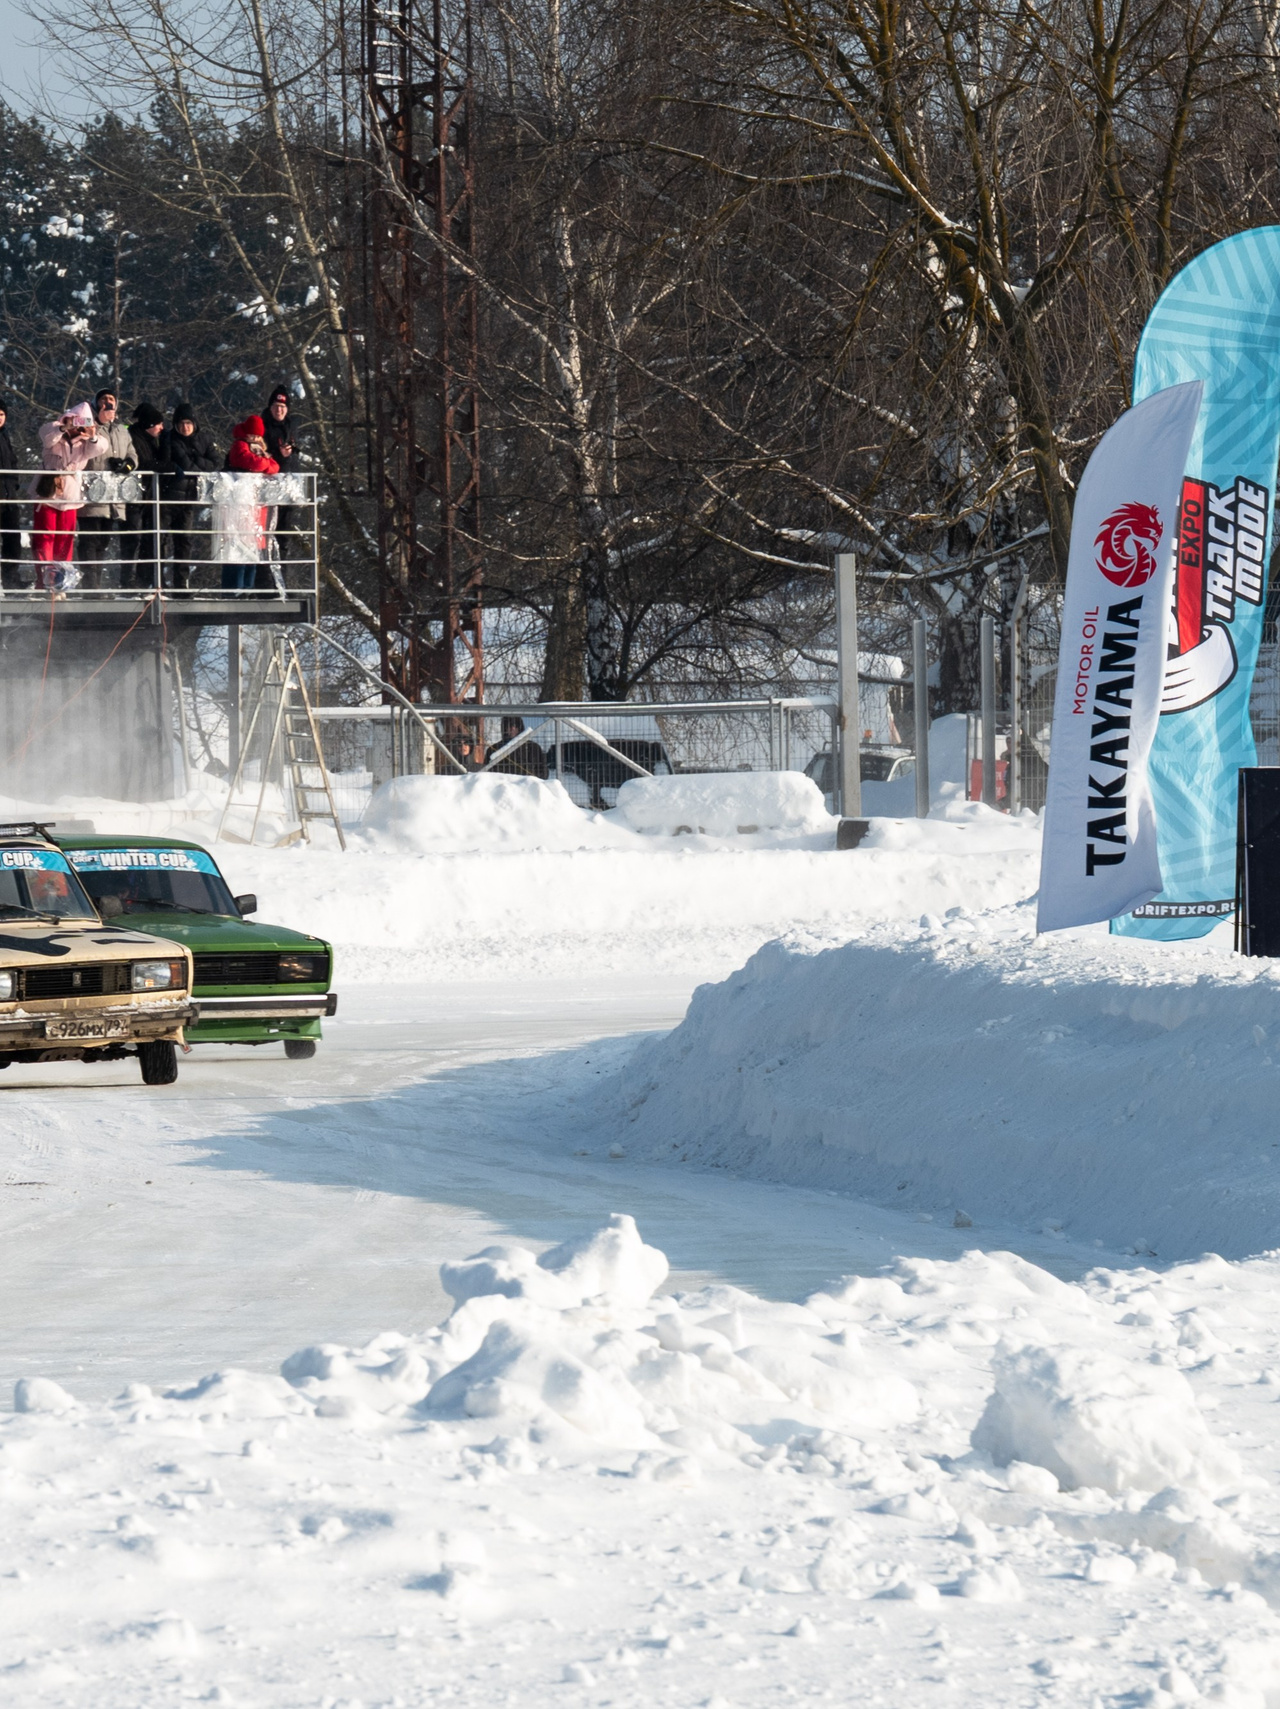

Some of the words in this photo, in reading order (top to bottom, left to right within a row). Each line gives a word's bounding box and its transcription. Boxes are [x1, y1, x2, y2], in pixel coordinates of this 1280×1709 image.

[1181, 499, 1202, 568] EXPO
[1206, 486, 1237, 620] TRACK
[1235, 480, 1266, 603] MODE
[1081, 605, 1100, 639] OIL
[1072, 643, 1095, 714] MOTOR
[1085, 594, 1144, 877] TAKAYAMA
[2, 852, 34, 867] CUP
[73, 855, 99, 863] DRIFT
[100, 853, 157, 867] WINTER
[158, 853, 188, 867] CUP
